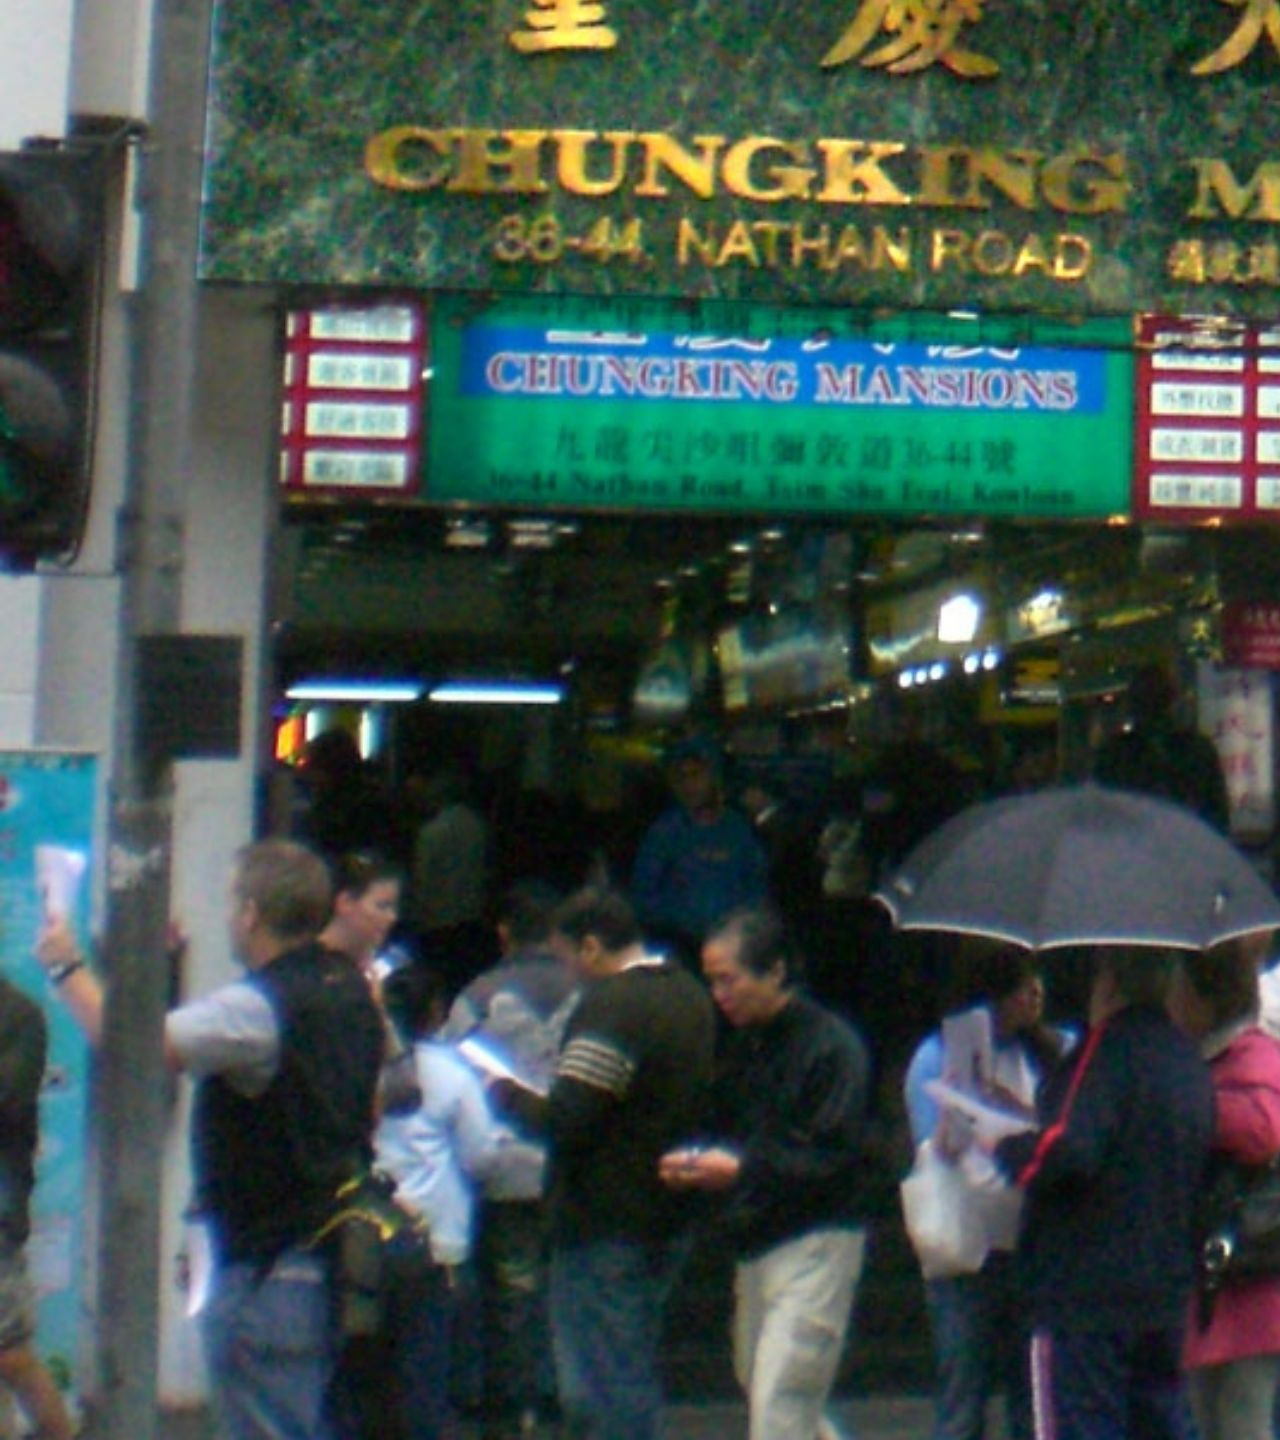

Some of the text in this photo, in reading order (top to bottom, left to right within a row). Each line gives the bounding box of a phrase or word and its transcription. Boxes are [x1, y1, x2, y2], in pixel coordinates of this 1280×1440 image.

[362, 124, 1128, 216] CHUNGKING
[677, 215, 911, 271] NATHAN
[931, 227, 1092, 281] ROAD
[486, 350, 1079, 411] CHUNGKING MANSIONS
